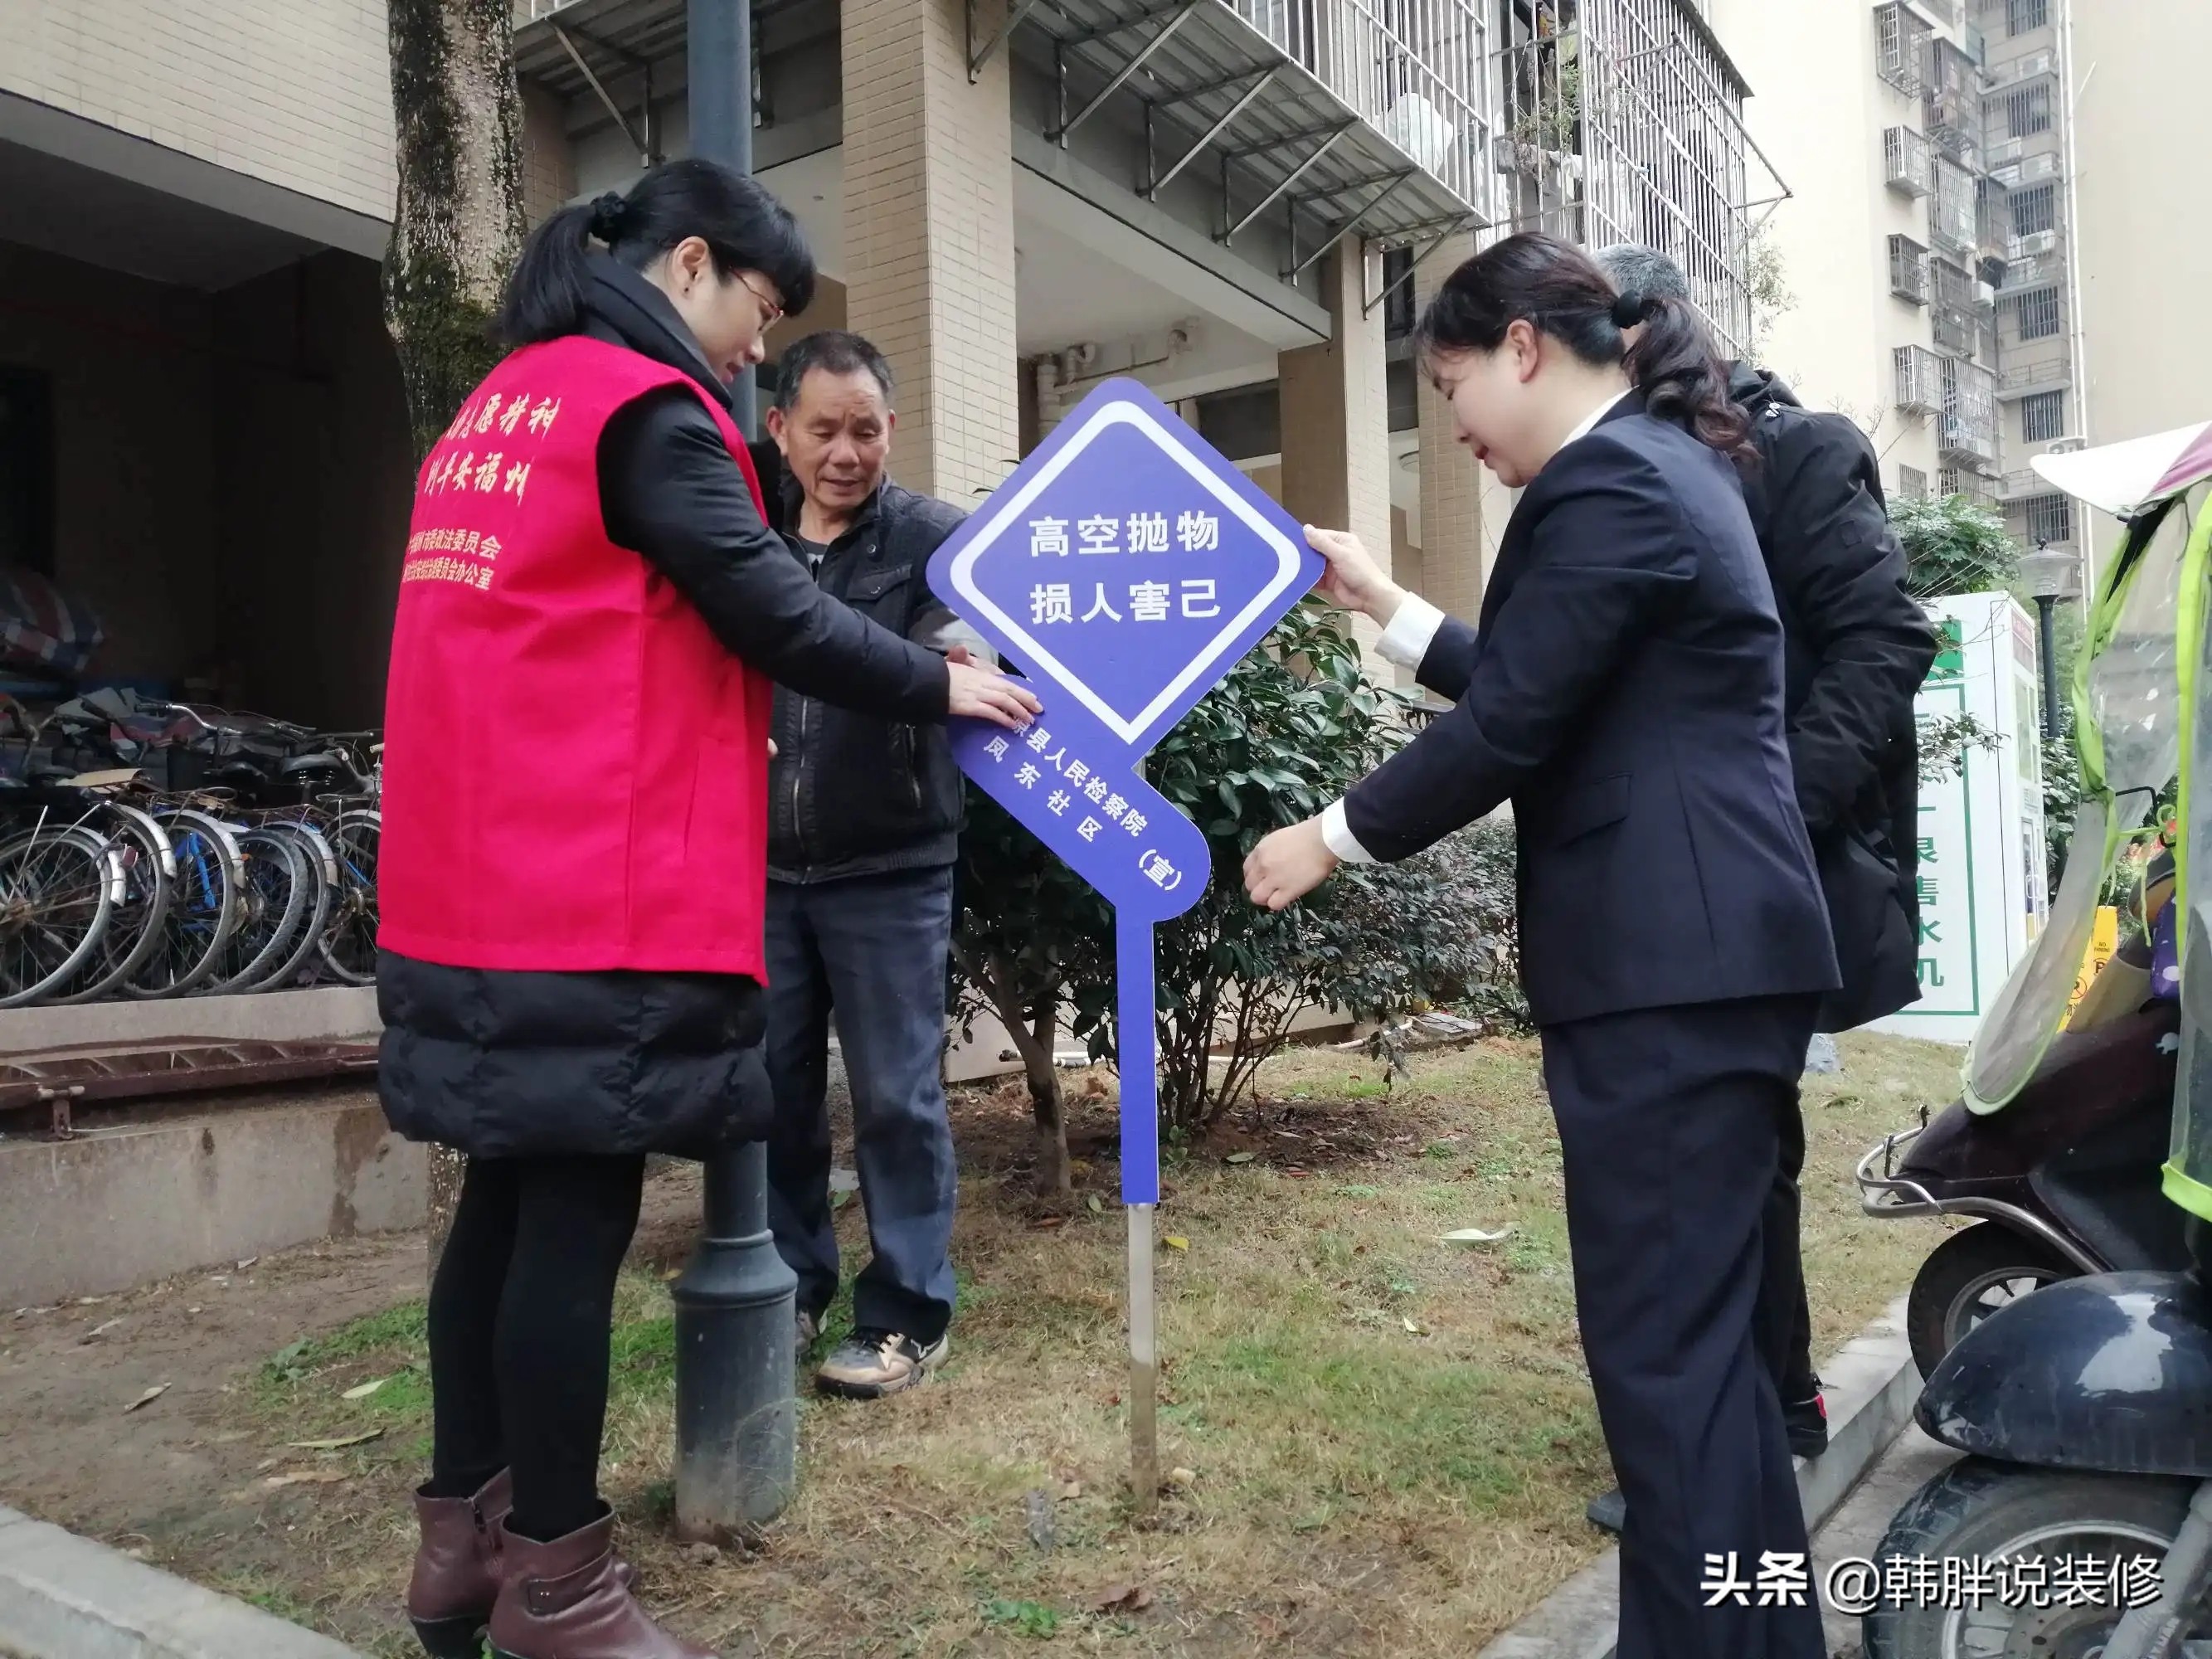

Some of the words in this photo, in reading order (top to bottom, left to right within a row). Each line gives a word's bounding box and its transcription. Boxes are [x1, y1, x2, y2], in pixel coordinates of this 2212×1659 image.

[1028, 510, 1220, 557] 高空抛物
[1028, 579, 1222, 625] 损人害己
[984, 736, 1103, 843] 凤东社区
